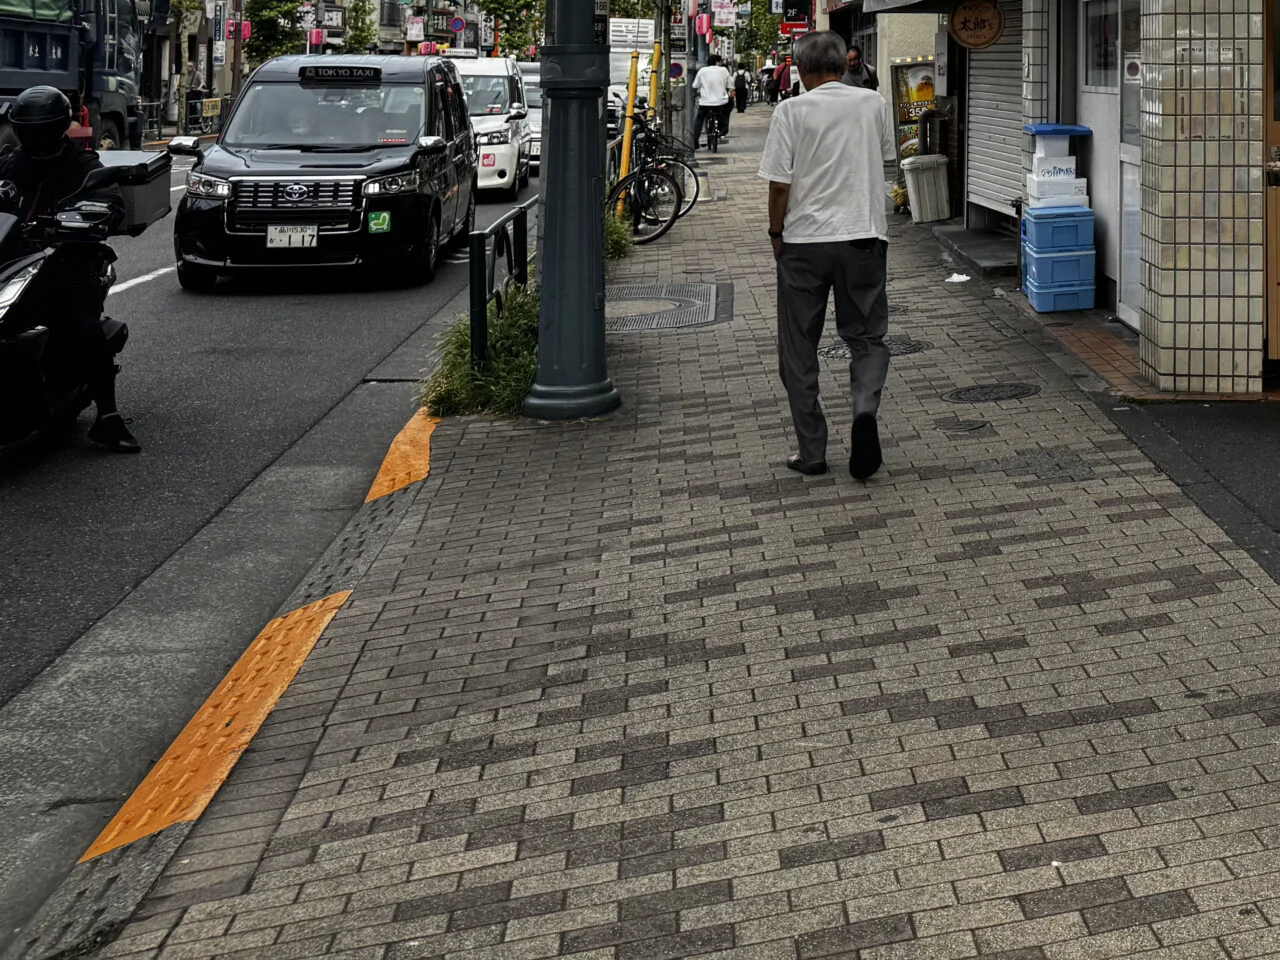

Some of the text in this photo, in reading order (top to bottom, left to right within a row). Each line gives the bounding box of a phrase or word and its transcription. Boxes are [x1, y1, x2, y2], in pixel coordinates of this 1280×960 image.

[786, 8, 797, 17] 2F
[318, 68, 375, 77] TOKYO TAXI
